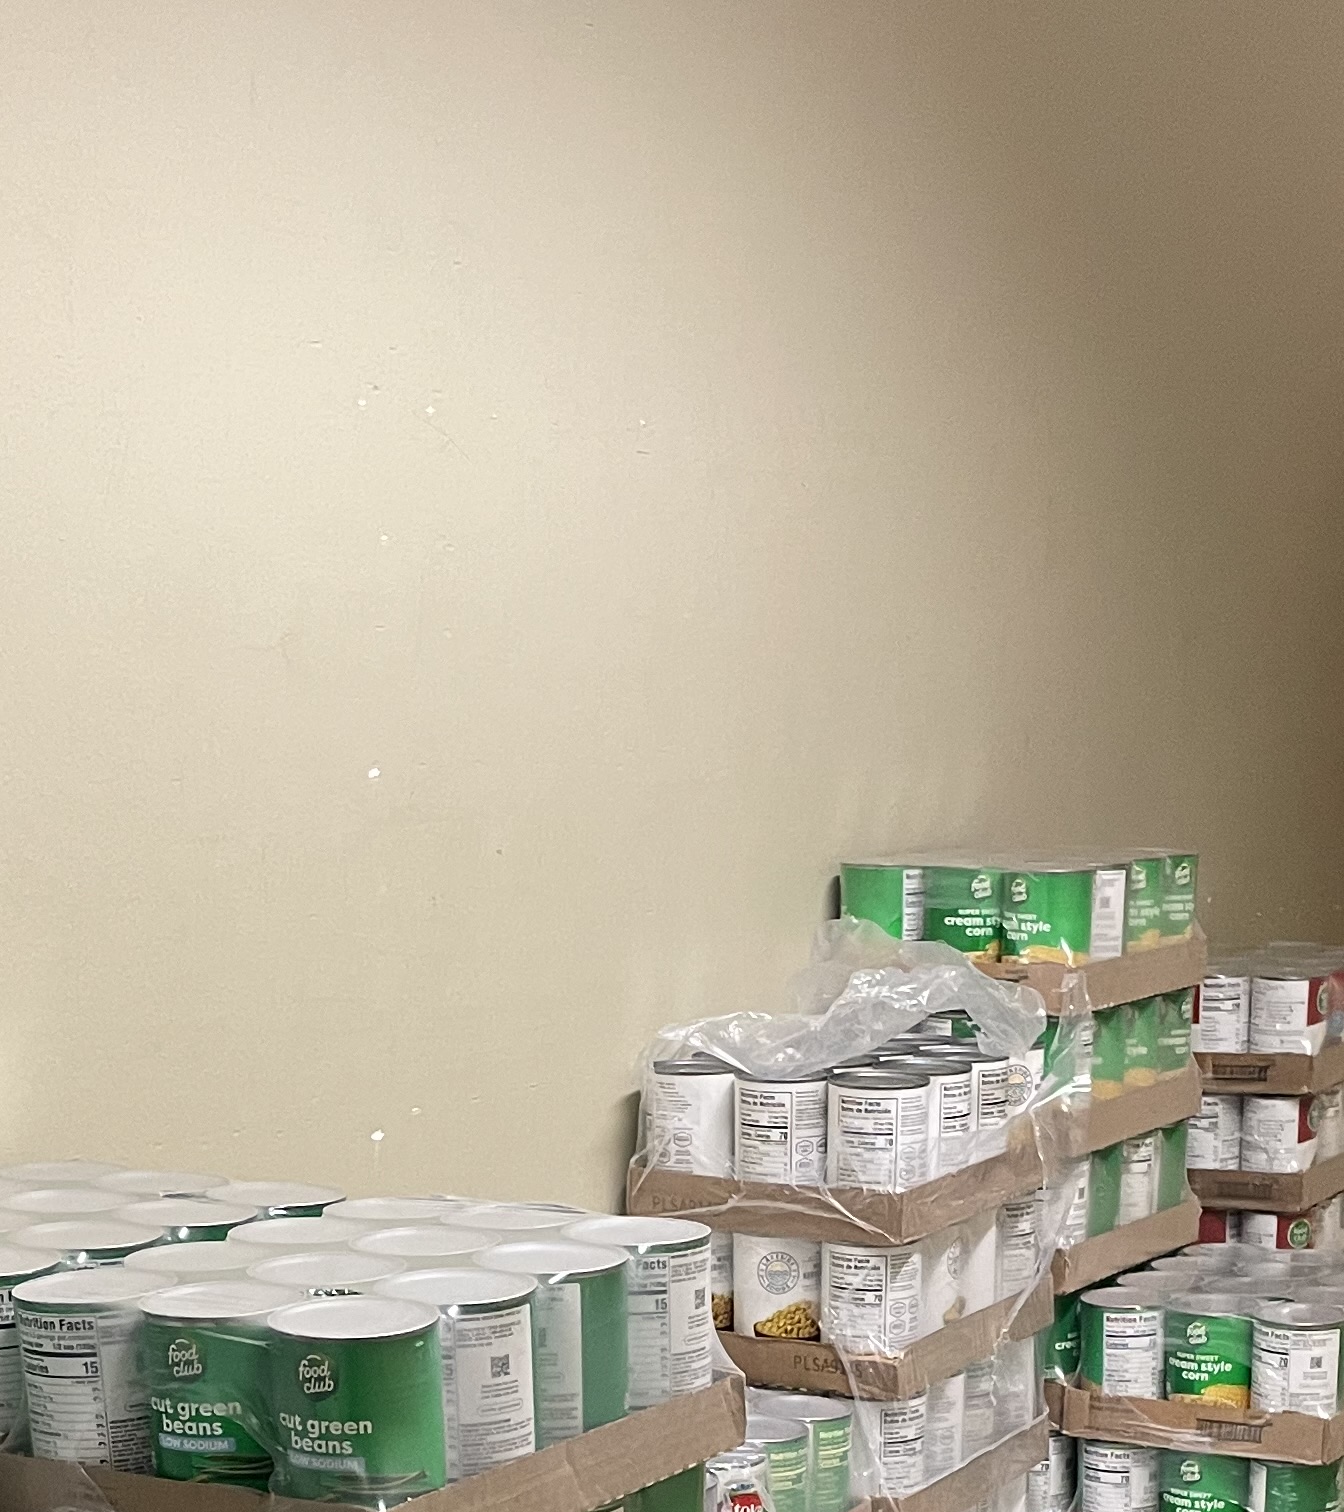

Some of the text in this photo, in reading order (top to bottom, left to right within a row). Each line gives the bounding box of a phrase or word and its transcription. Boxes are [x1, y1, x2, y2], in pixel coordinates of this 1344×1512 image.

[944, 916, 984, 926] cream
[1020, 921, 1051, 934] style
[966, 927, 993, 936] corn
[655, 1298, 667, 1311] 15
[59, 1319, 94, 1331] Facts
[168, 1343, 198, 1366] food
[82, 1361, 98, 1374] 15
[174, 1362, 203, 1379] club
[299, 1359, 330, 1382] food
[1169, 1357, 1232, 1374] cream style
[1182, 1371, 1208, 1380] corn
[303, 1376, 334, 1395] club
[178, 1400, 242, 1419] green
[163, 1416, 223, 1436] beans
[280, 1411, 373, 1437] cut green
[183, 1438, 228, 1451] SODIUM
[291, 1432, 353, 1455] beans
[1200, 1497, 1225, 1511] style
